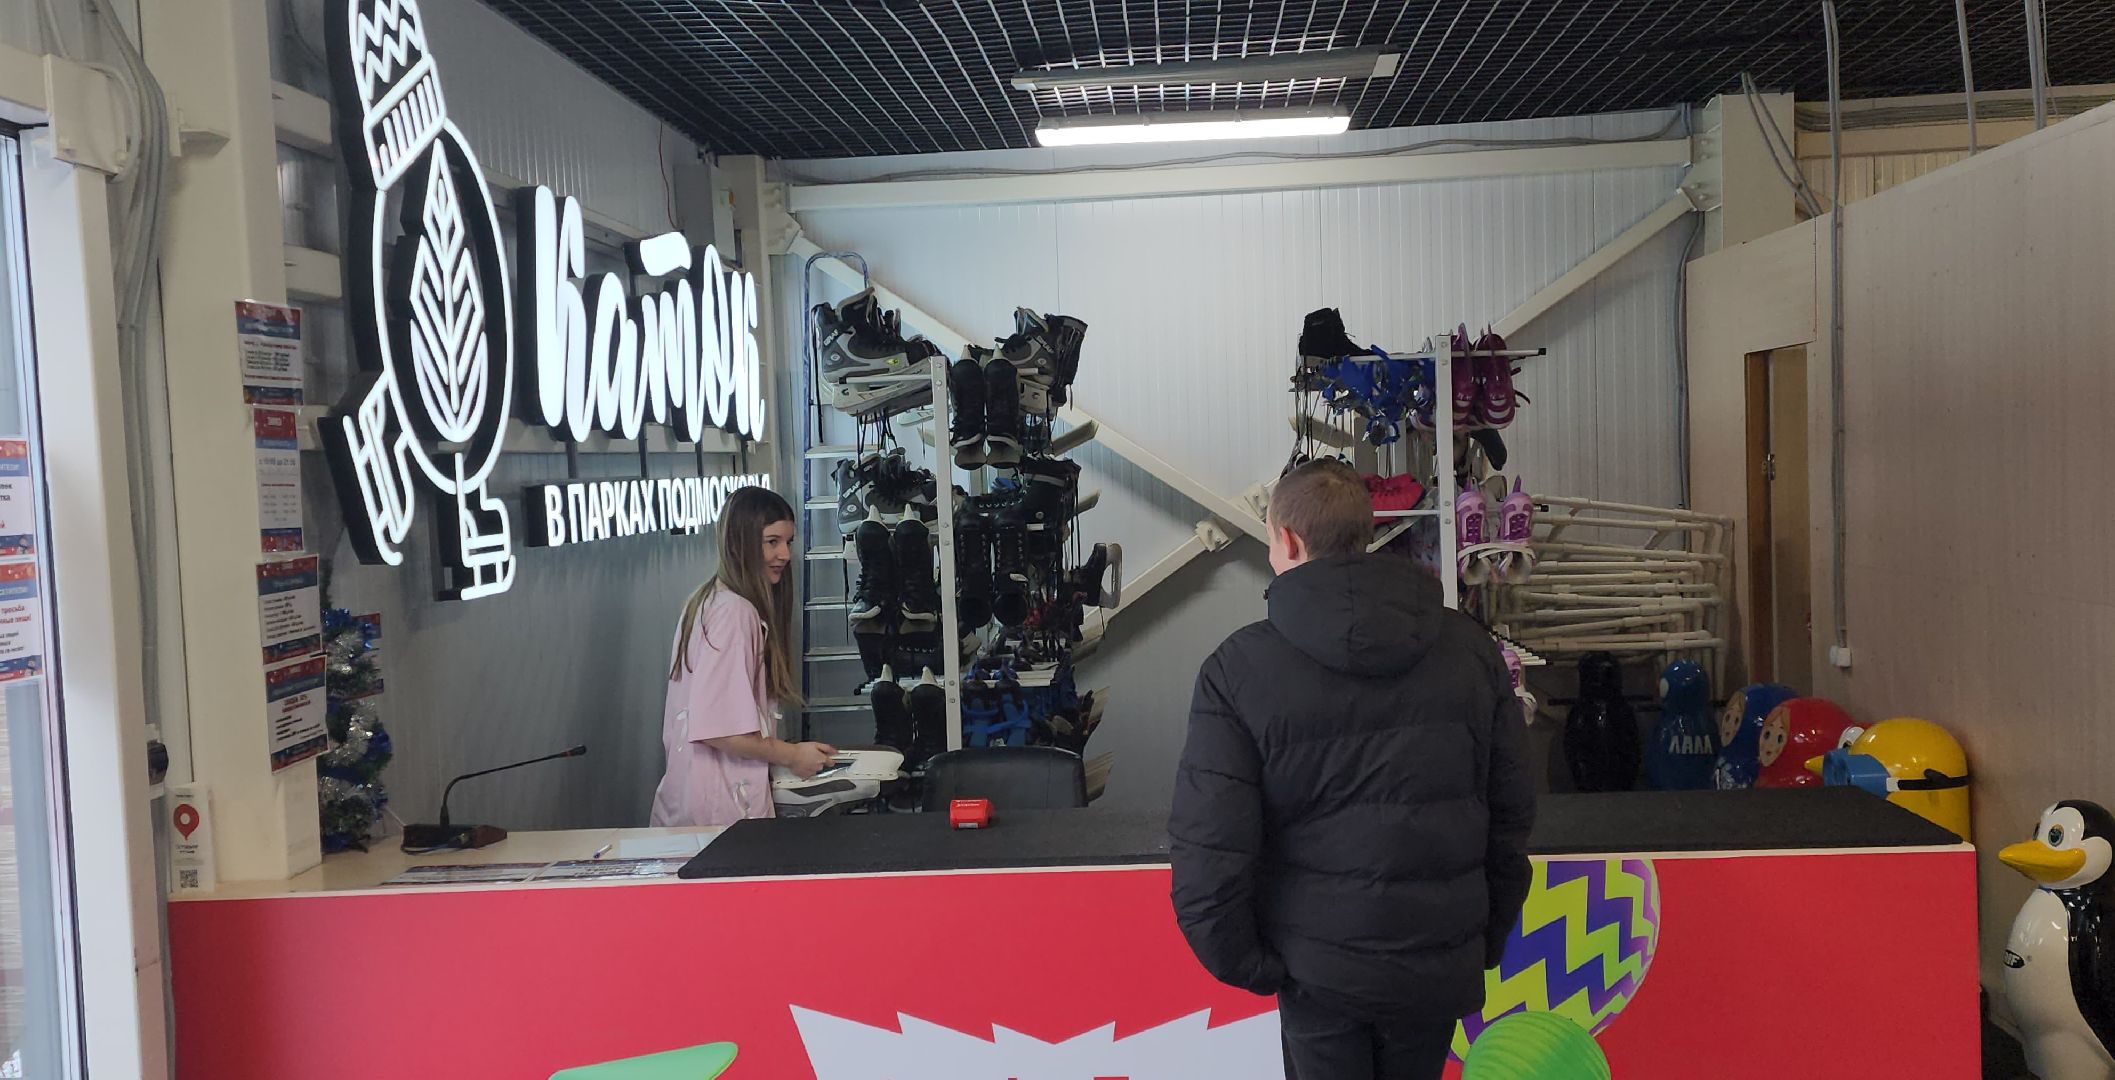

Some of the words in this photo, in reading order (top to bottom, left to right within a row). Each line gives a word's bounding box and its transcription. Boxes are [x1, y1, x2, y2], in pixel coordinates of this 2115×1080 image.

[544, 483, 566, 547] В
[567, 479, 657, 544] ПАРКАХ
[657, 473, 770, 536] ПОДМОС
